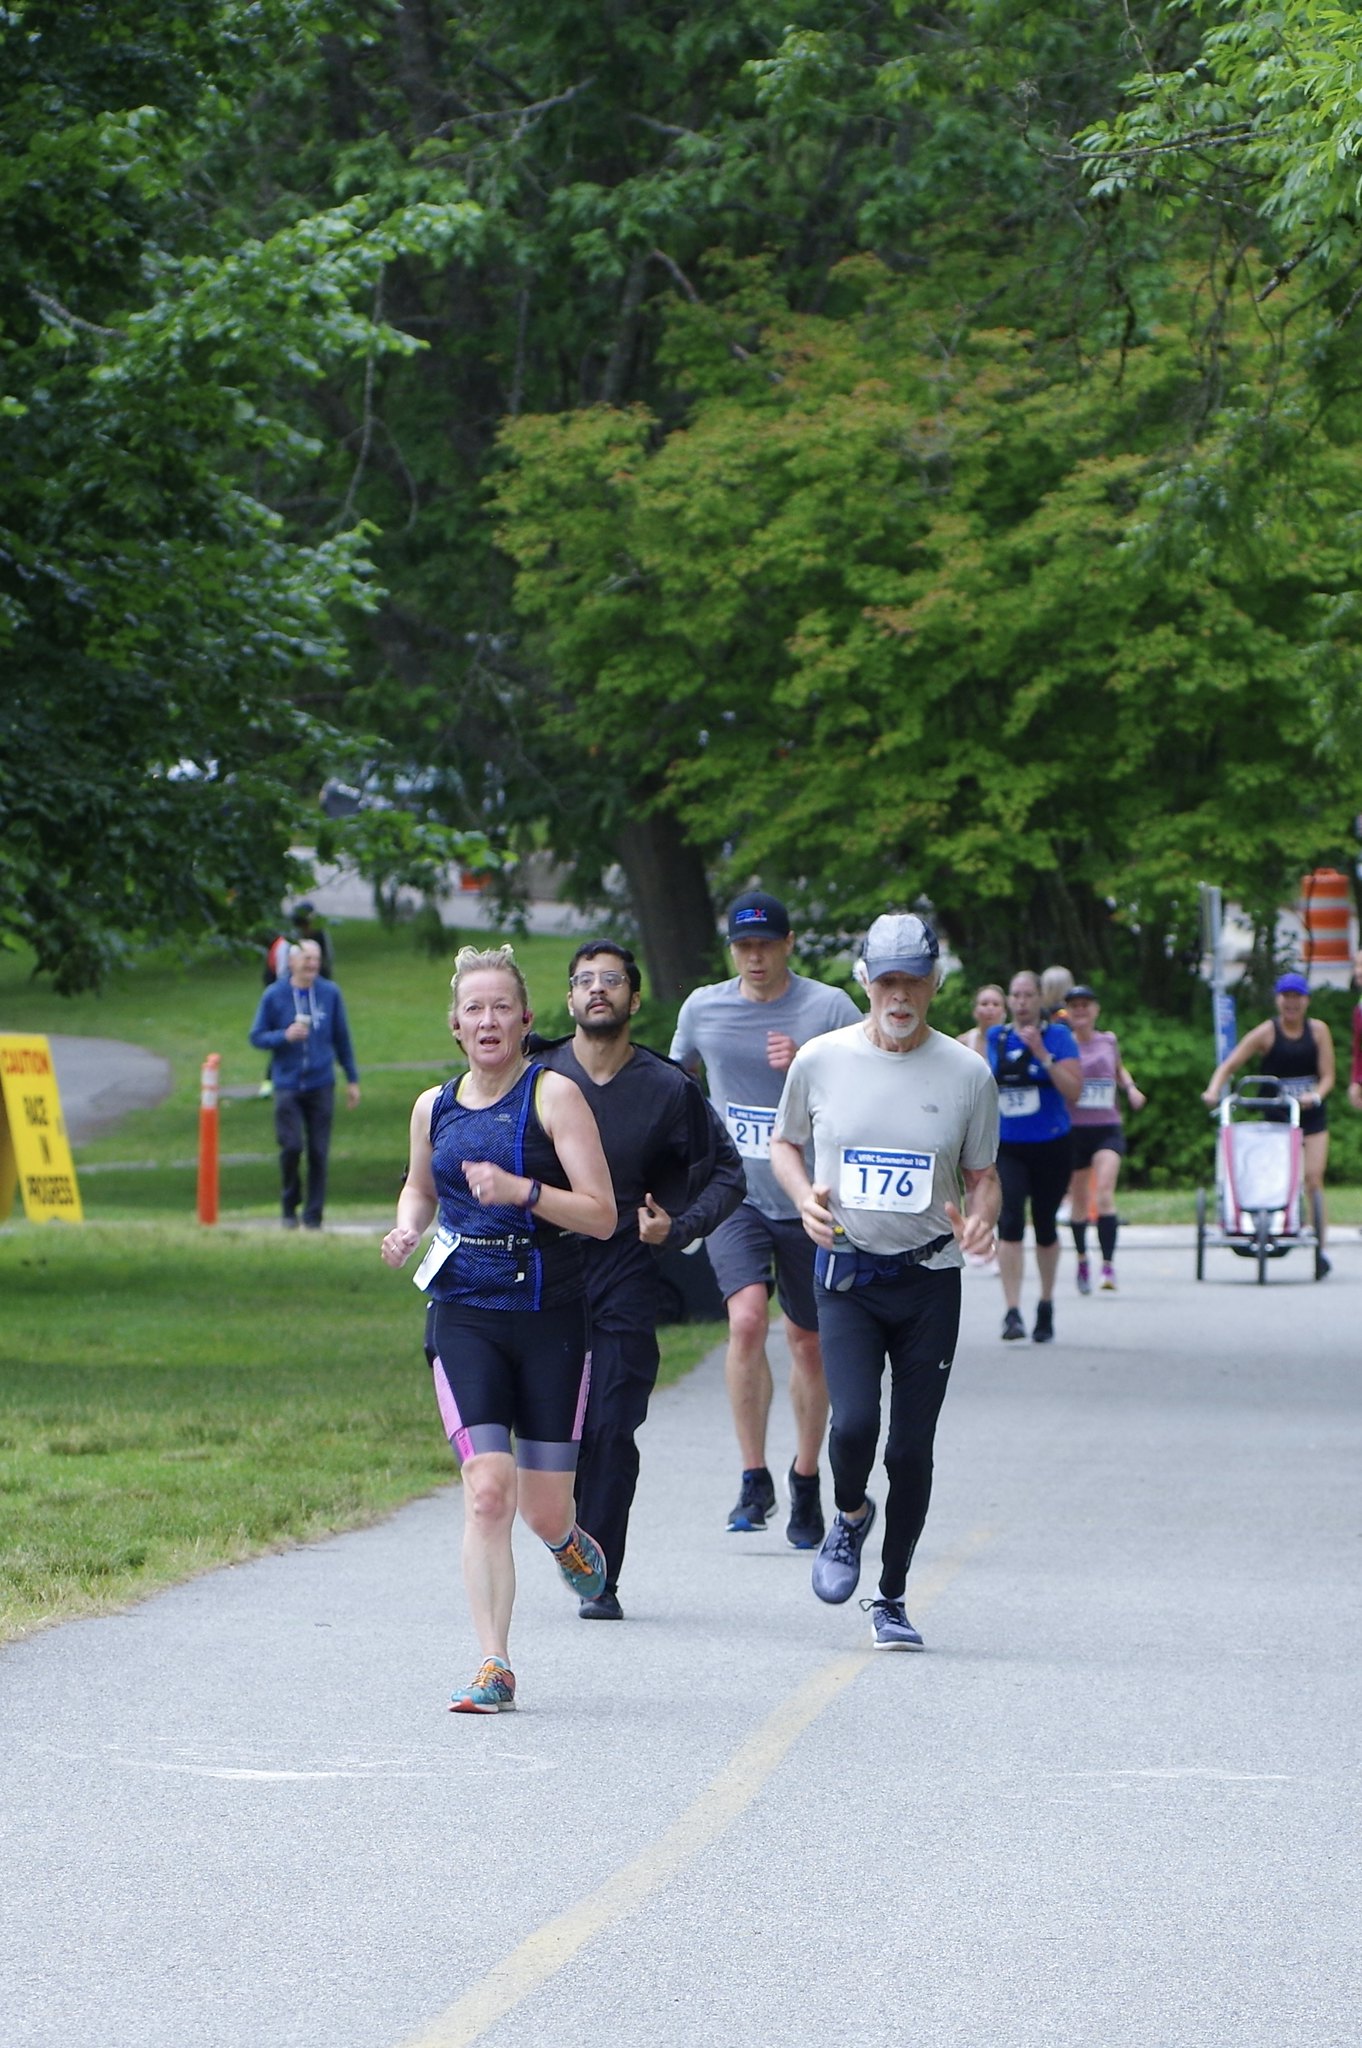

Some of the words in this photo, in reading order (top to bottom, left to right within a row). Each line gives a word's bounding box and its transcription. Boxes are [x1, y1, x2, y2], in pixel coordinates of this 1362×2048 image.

[0, 1049, 50, 1075] CAUTION
[23, 1096, 49, 1126] RACE
[26, 1176, 74, 1205] PROGRESS
[858, 1167, 913, 1197] 176
